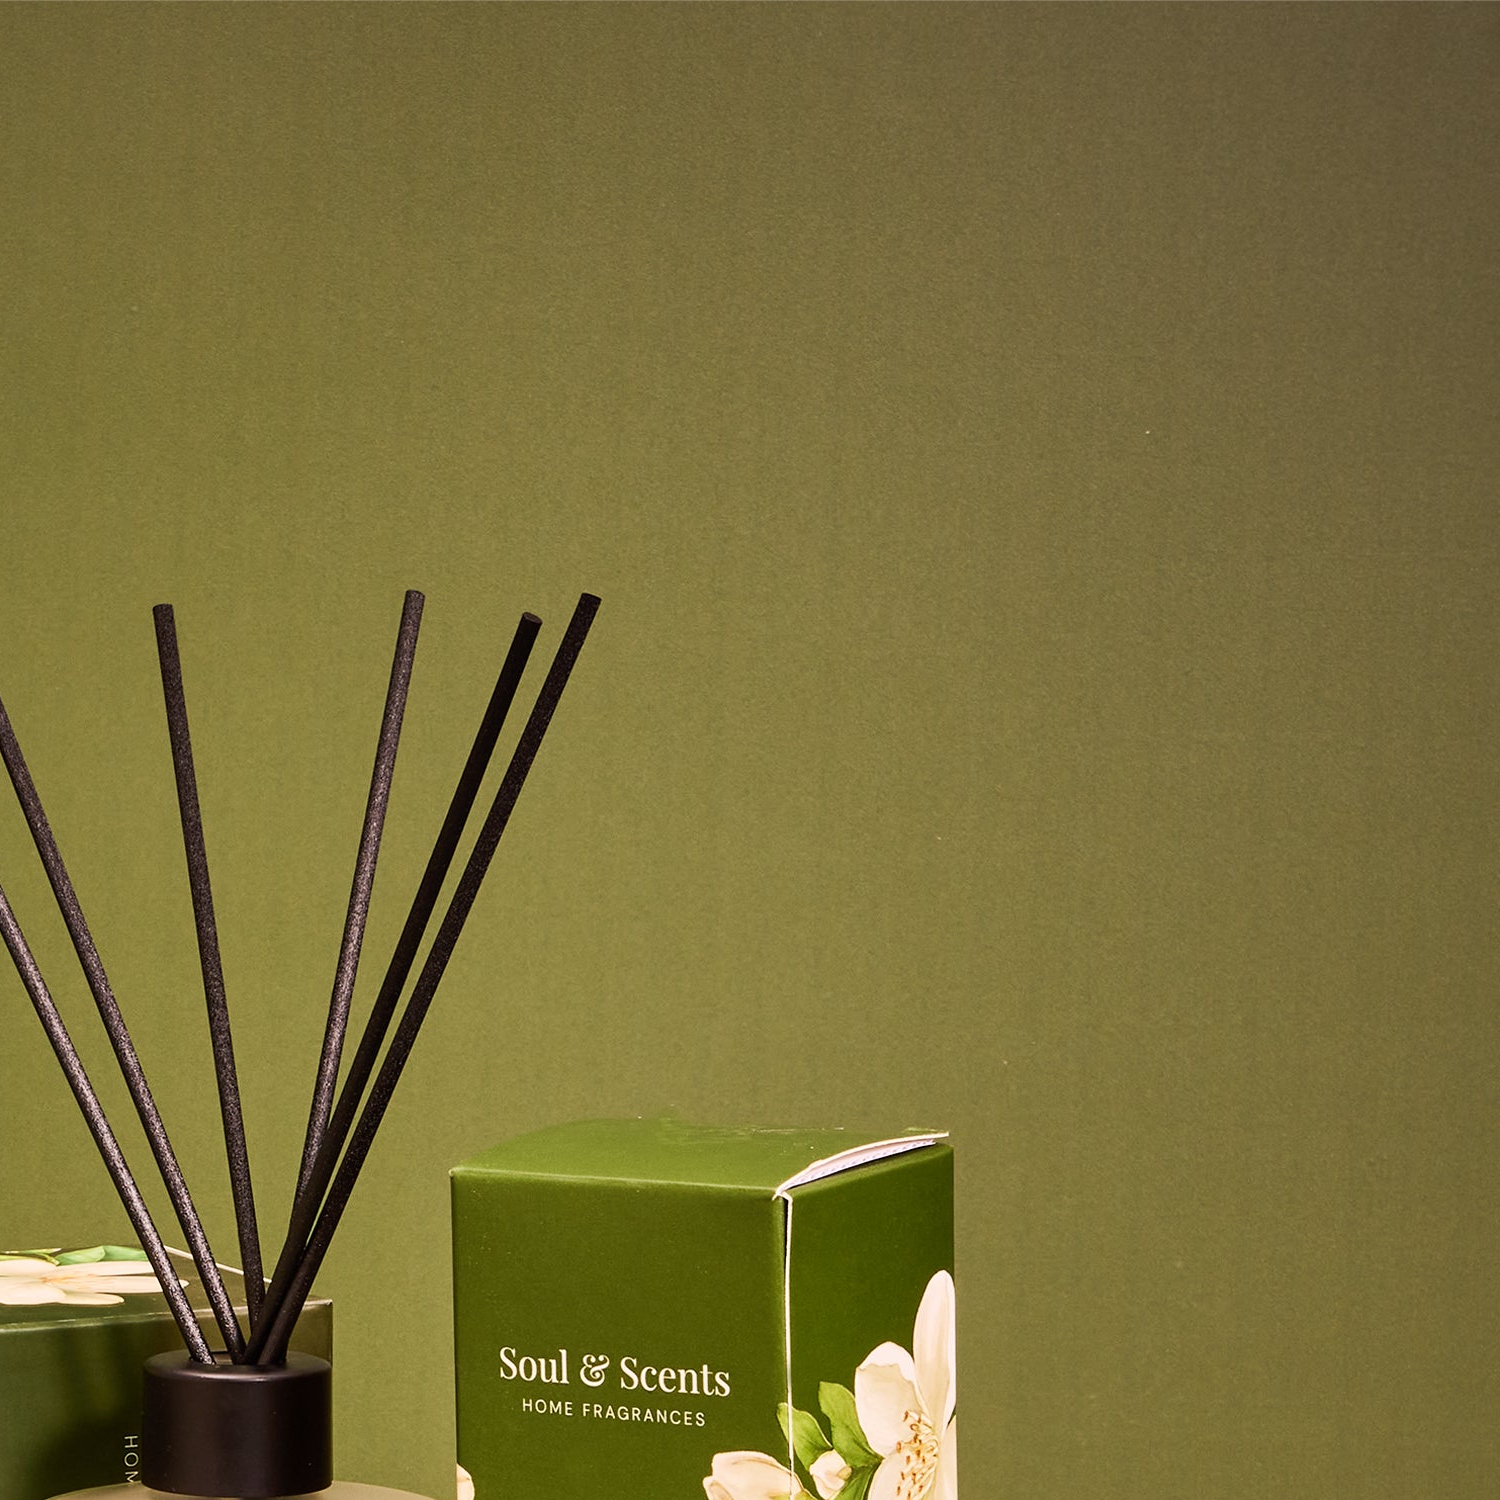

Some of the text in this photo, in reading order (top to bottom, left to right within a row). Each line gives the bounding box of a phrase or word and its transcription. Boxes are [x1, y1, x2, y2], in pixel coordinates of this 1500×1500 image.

[500, 1346, 731, 1397] Soul & Scents
[522, 1398, 706, 1427] HOME FRAGRANCES
